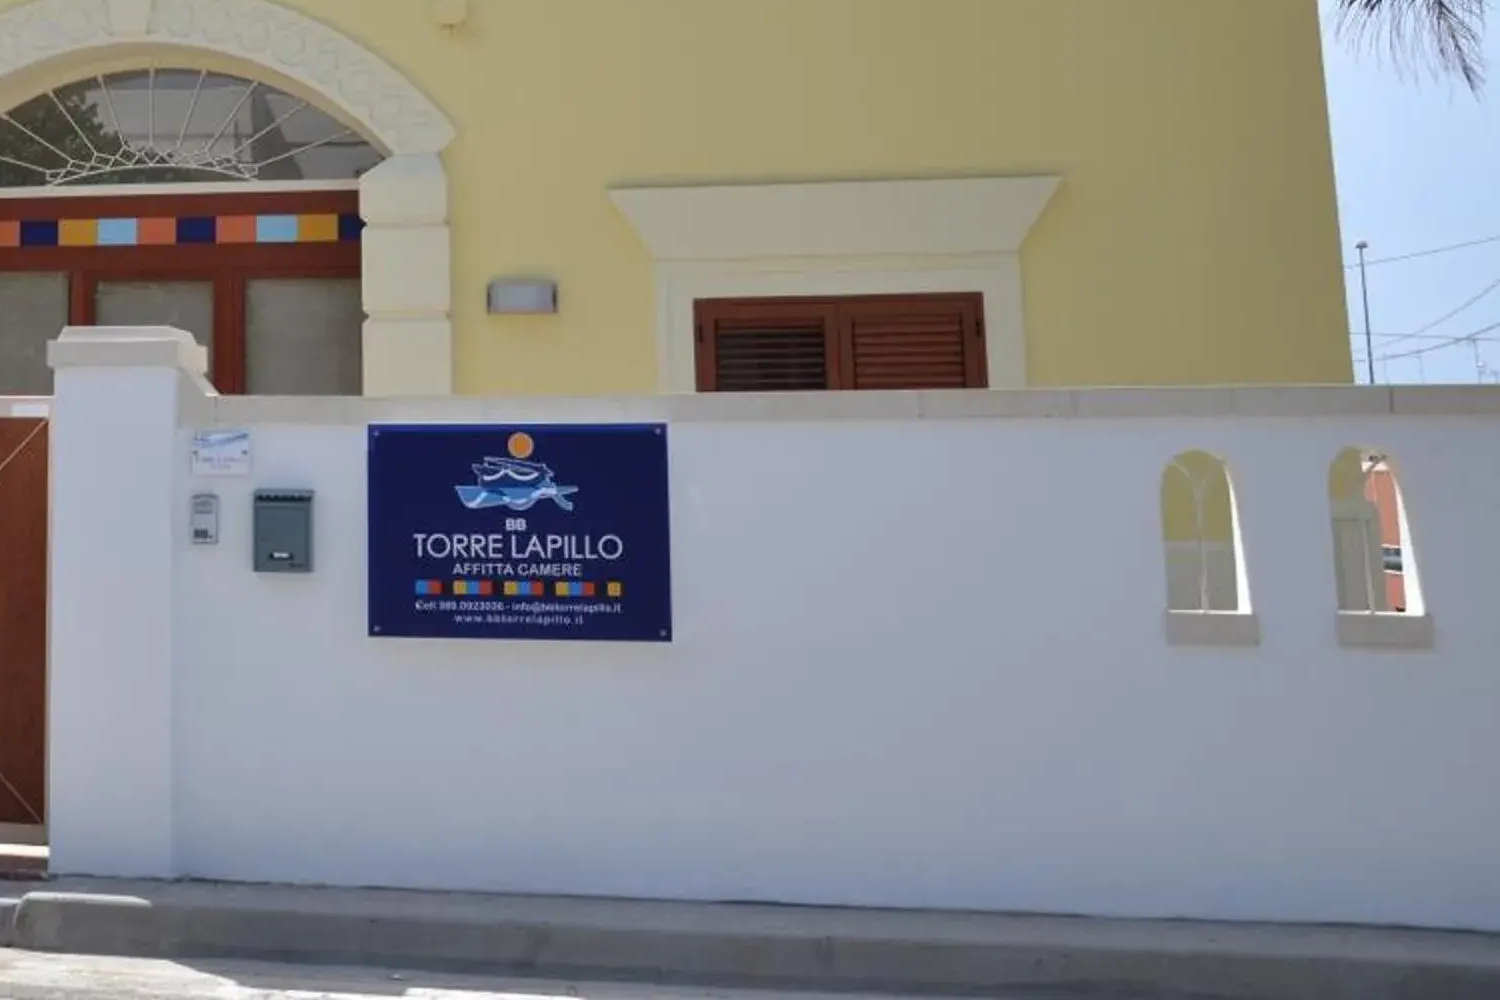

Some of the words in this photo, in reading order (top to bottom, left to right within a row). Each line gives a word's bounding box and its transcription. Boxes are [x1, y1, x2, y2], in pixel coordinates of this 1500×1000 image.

[505, 517, 527, 531] BB
[413, 533, 503, 558] TORRE
[511, 534, 623, 559] LAPILLO
[452, 563, 514, 575] AFFITTA
[517, 563, 582, 577] CAMERE
